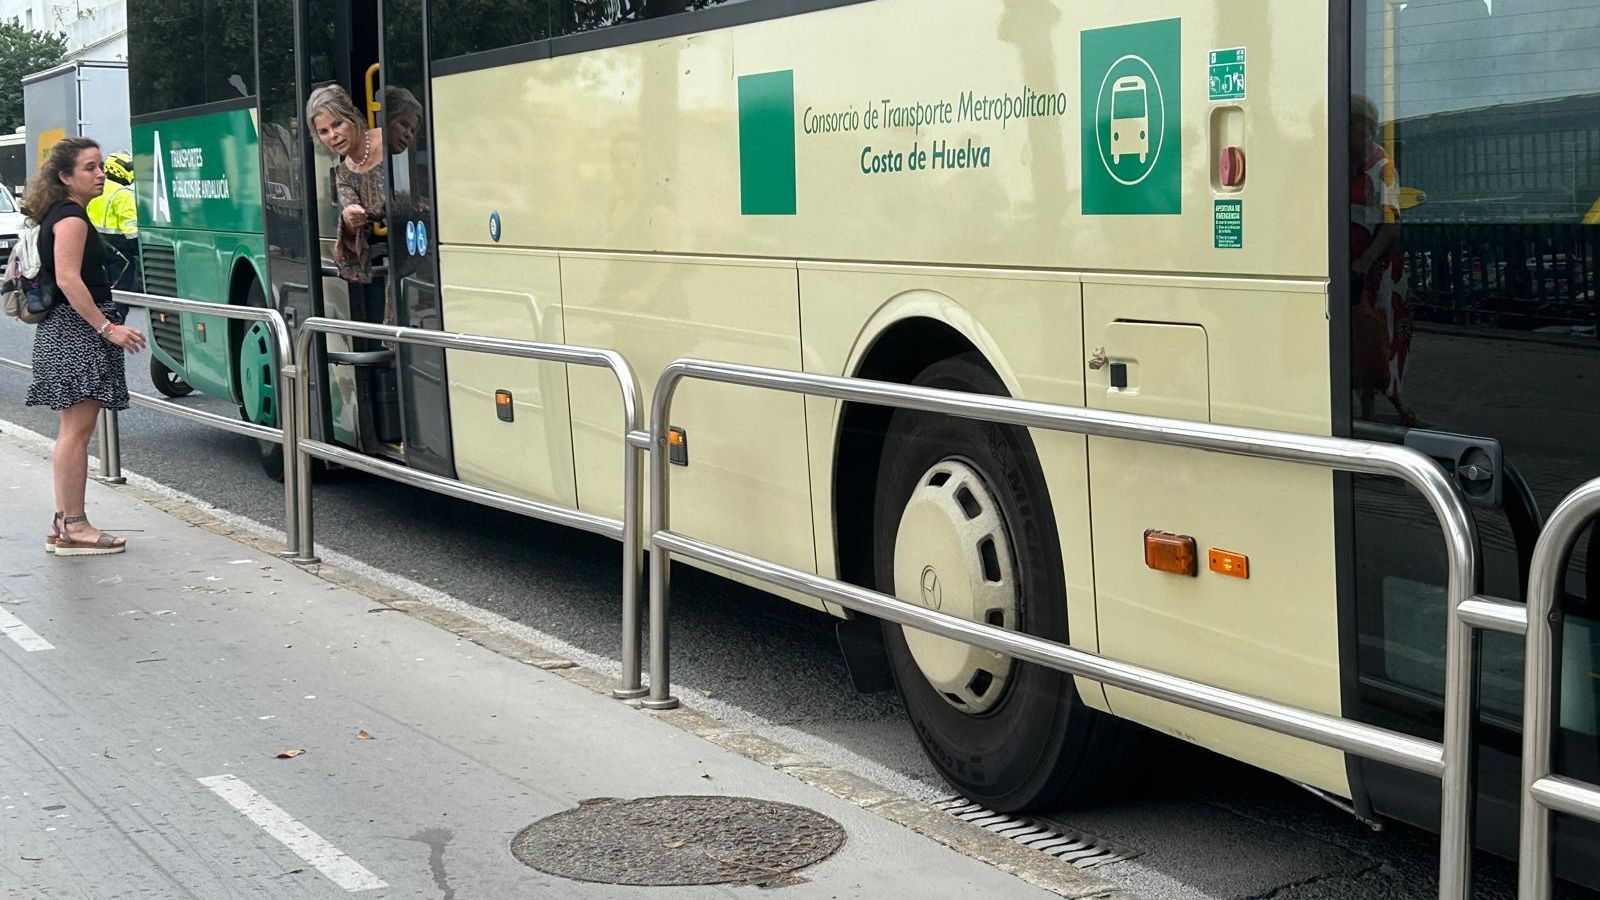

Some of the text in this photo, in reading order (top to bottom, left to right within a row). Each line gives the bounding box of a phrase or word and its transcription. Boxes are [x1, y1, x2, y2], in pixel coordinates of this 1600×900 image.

[804, 85, 1067, 134] Consorcio de Transporte Metropolitano
[170, 147, 203, 168] TRANSPORTES
[861, 138, 991, 174] Costa de Huelva
[172, 174, 229, 198] PÚBLICOS DE ANDALUCÍA
